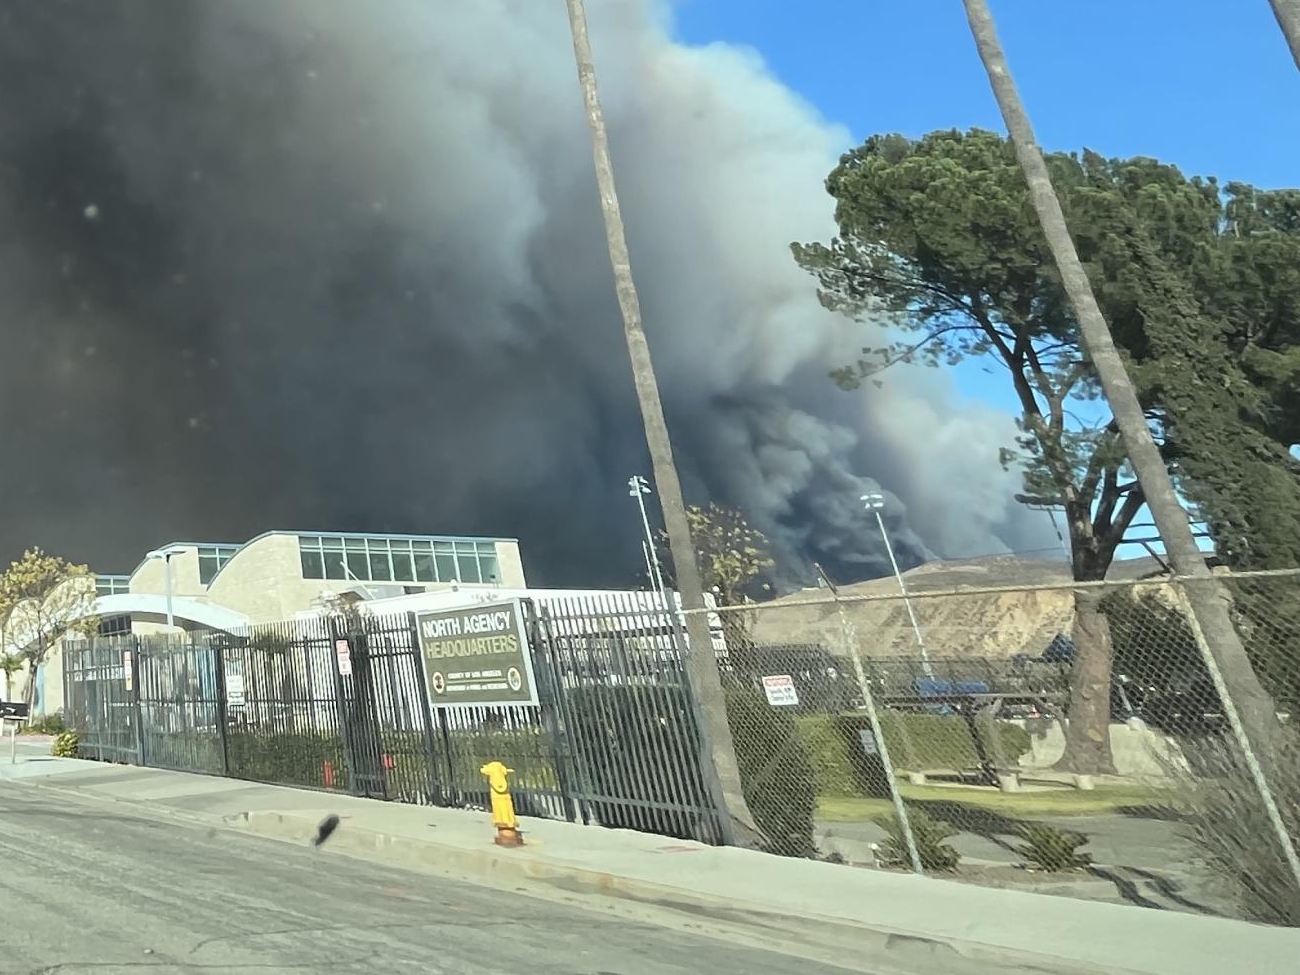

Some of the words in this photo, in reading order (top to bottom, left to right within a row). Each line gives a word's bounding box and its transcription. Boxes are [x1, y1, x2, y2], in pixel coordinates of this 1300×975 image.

[422, 617, 461, 638] NORTH
[463, 611, 510, 634] AGENCY
[425, 634, 517, 659] HEADQUARTERS
